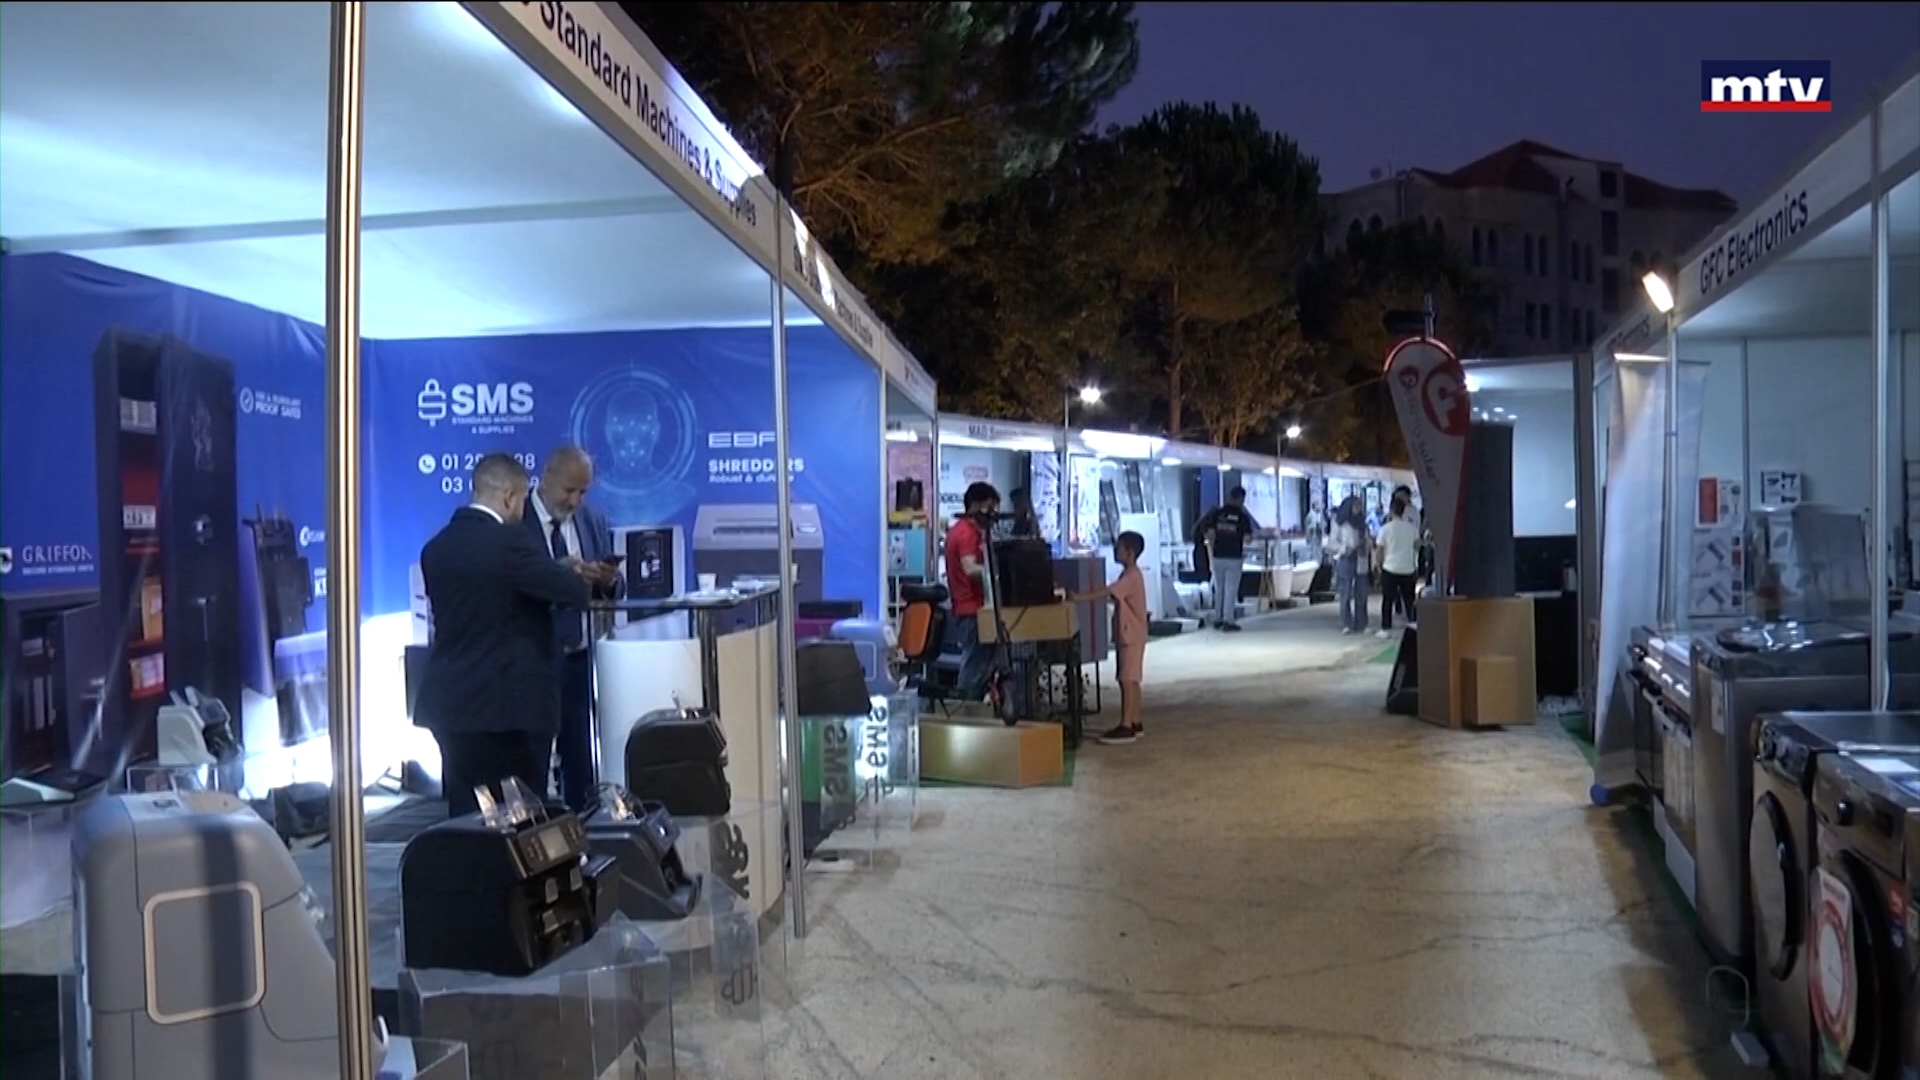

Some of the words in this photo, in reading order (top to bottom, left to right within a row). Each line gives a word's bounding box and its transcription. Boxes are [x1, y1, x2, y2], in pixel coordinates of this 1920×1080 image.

[540, 1, 631, 109] Standard
[636, 74, 701, 176] Machines
[1700, 245, 1724, 296] GFC
[1727, 189, 1808, 278] Electronics
[451, 382, 534, 416] SMS
[441, 453, 459, 470] 01
[708, 458, 804, 473] SHREDDRS
[441, 476, 463, 493] 03
